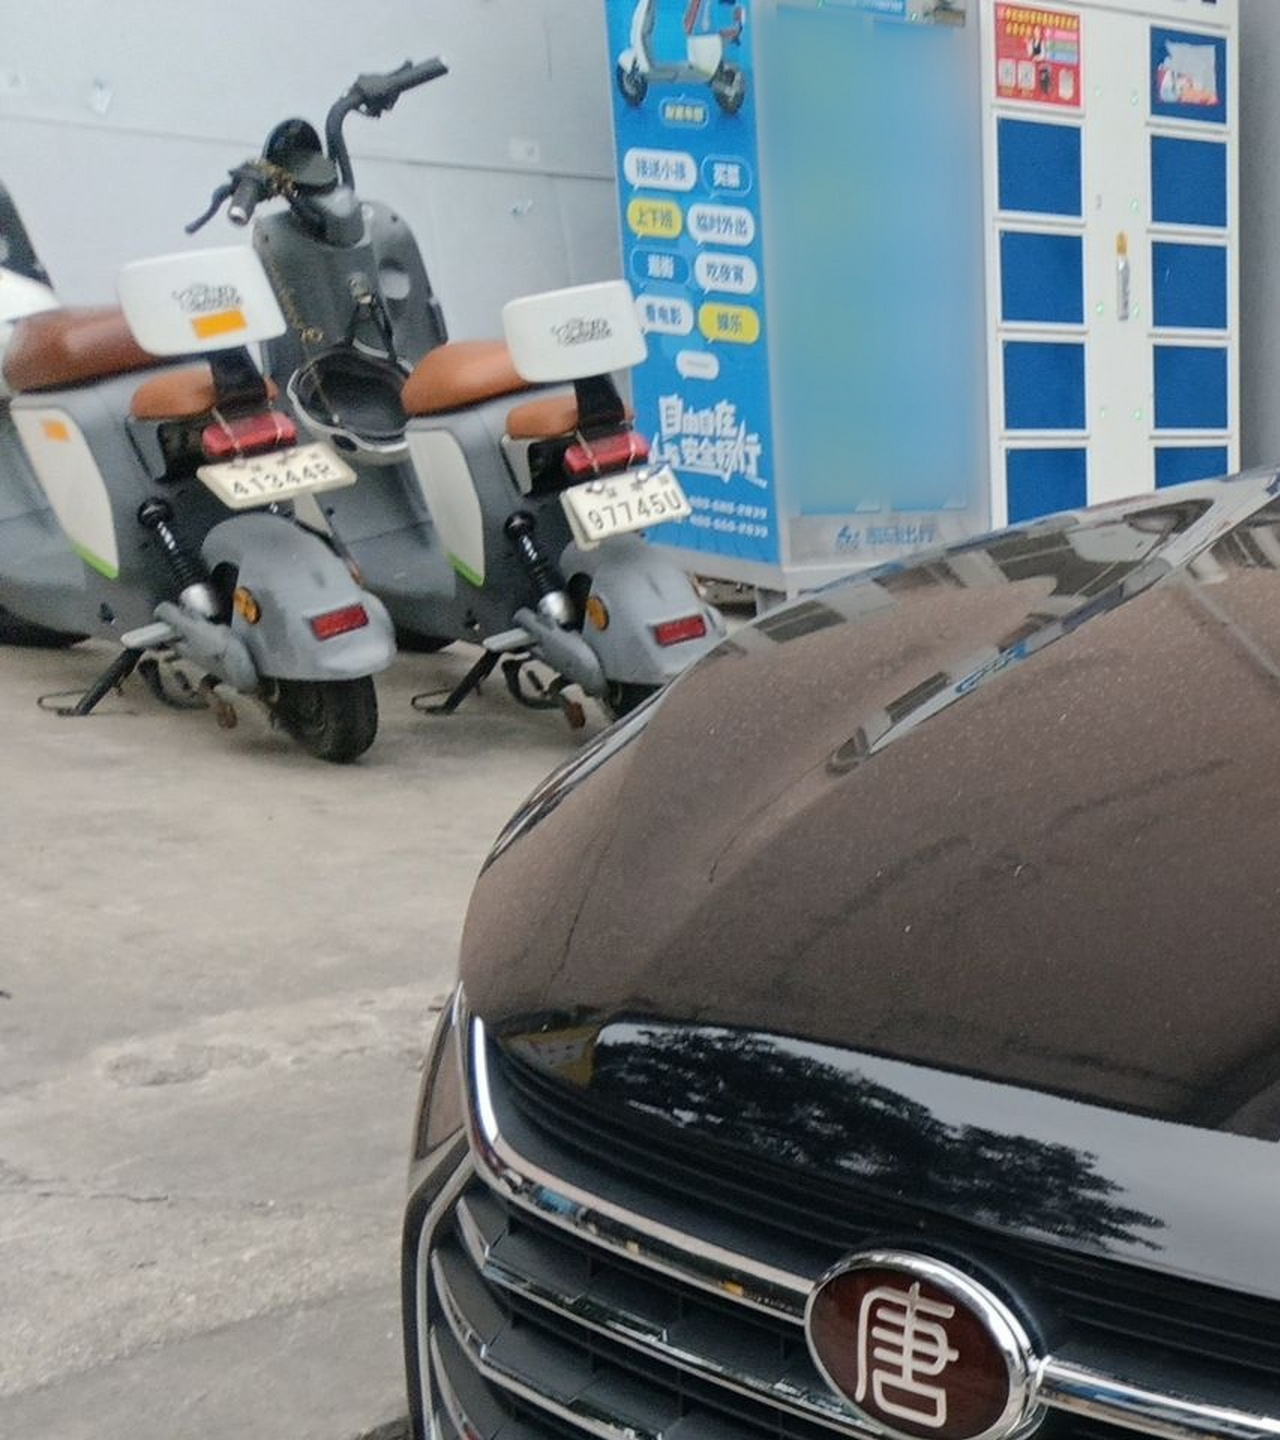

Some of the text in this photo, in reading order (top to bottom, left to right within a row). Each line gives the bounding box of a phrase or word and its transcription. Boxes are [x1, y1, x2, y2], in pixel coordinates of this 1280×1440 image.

[658, 393, 738, 442] 自由自在
[855, 1281, 960, 1428] 唐
